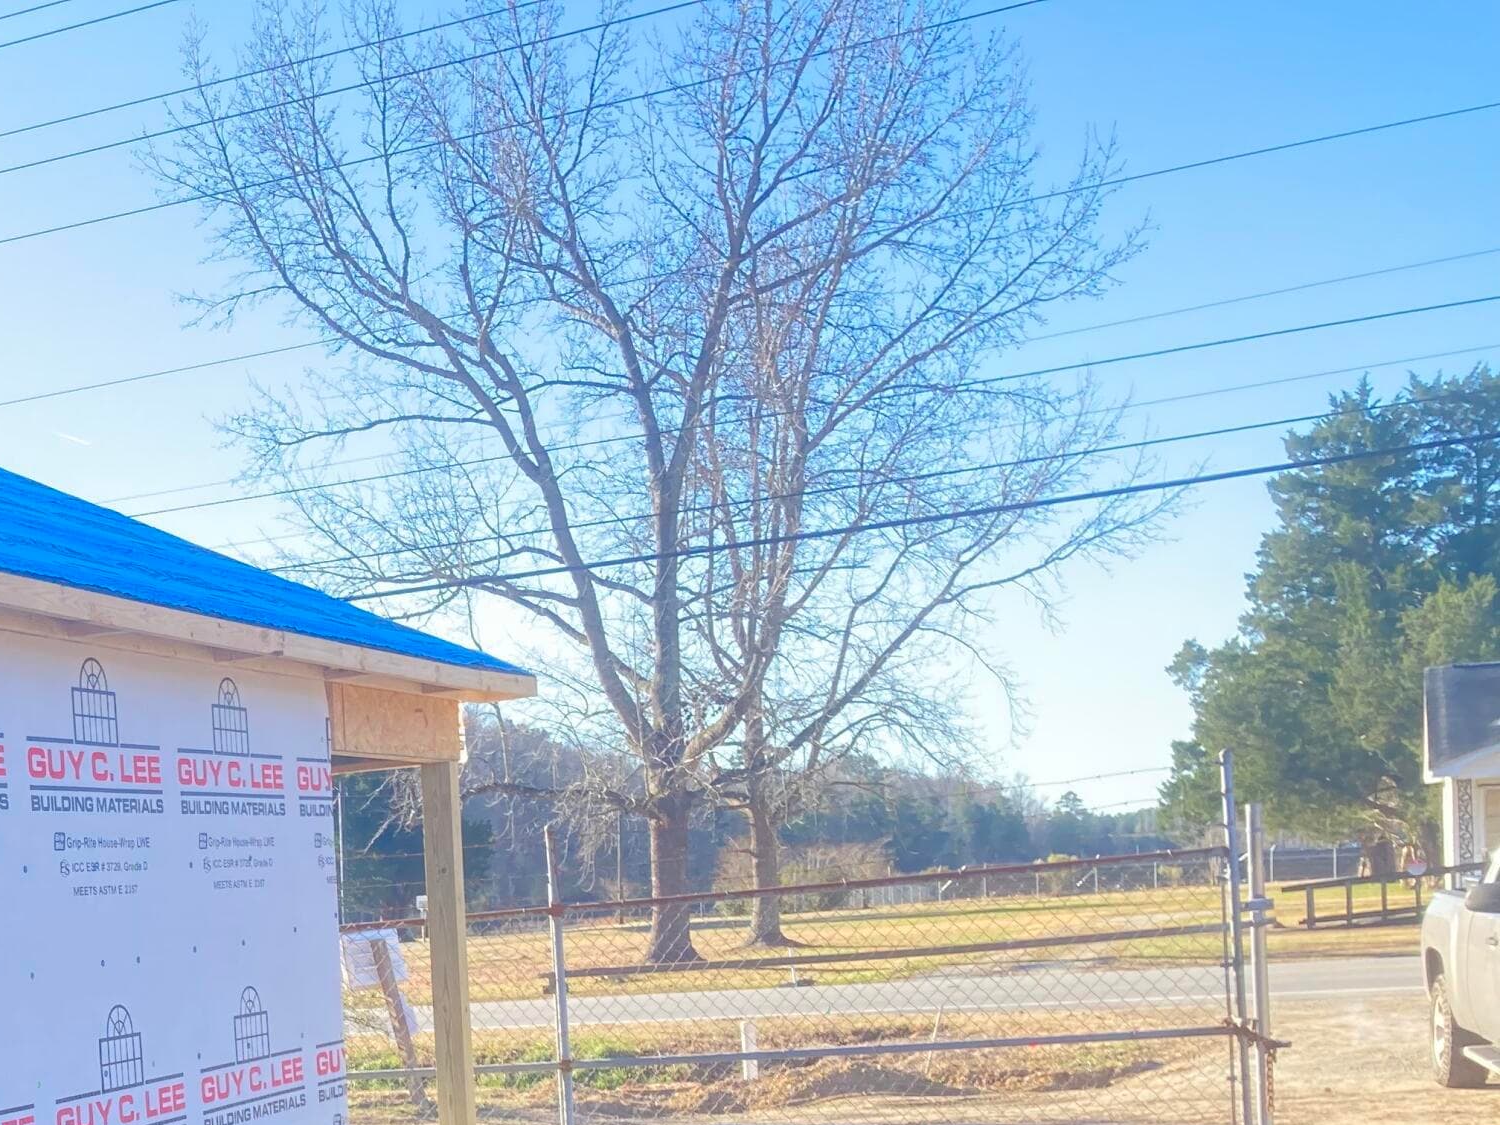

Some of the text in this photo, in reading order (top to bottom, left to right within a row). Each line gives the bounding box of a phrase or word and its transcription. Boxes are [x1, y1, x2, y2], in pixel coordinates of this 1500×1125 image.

[27, 746, 161, 784] GUY C. LEE
[177, 757, 284, 789] GUY C. LEE
[297, 766, 332, 791] GUY
[31, 794, 164, 814] BUILDING MATERIALS
[181, 800, 286, 816] BUILDING MATERIALS
[300, 804, 333, 816] BUILDIN
[201, 1056, 304, 1104] GUY C. LEE
[118, 1094, 140, 1124] C.
[145, 1082, 186, 1117] LEE
[253, 1094, 306, 1120] MATERIALS
